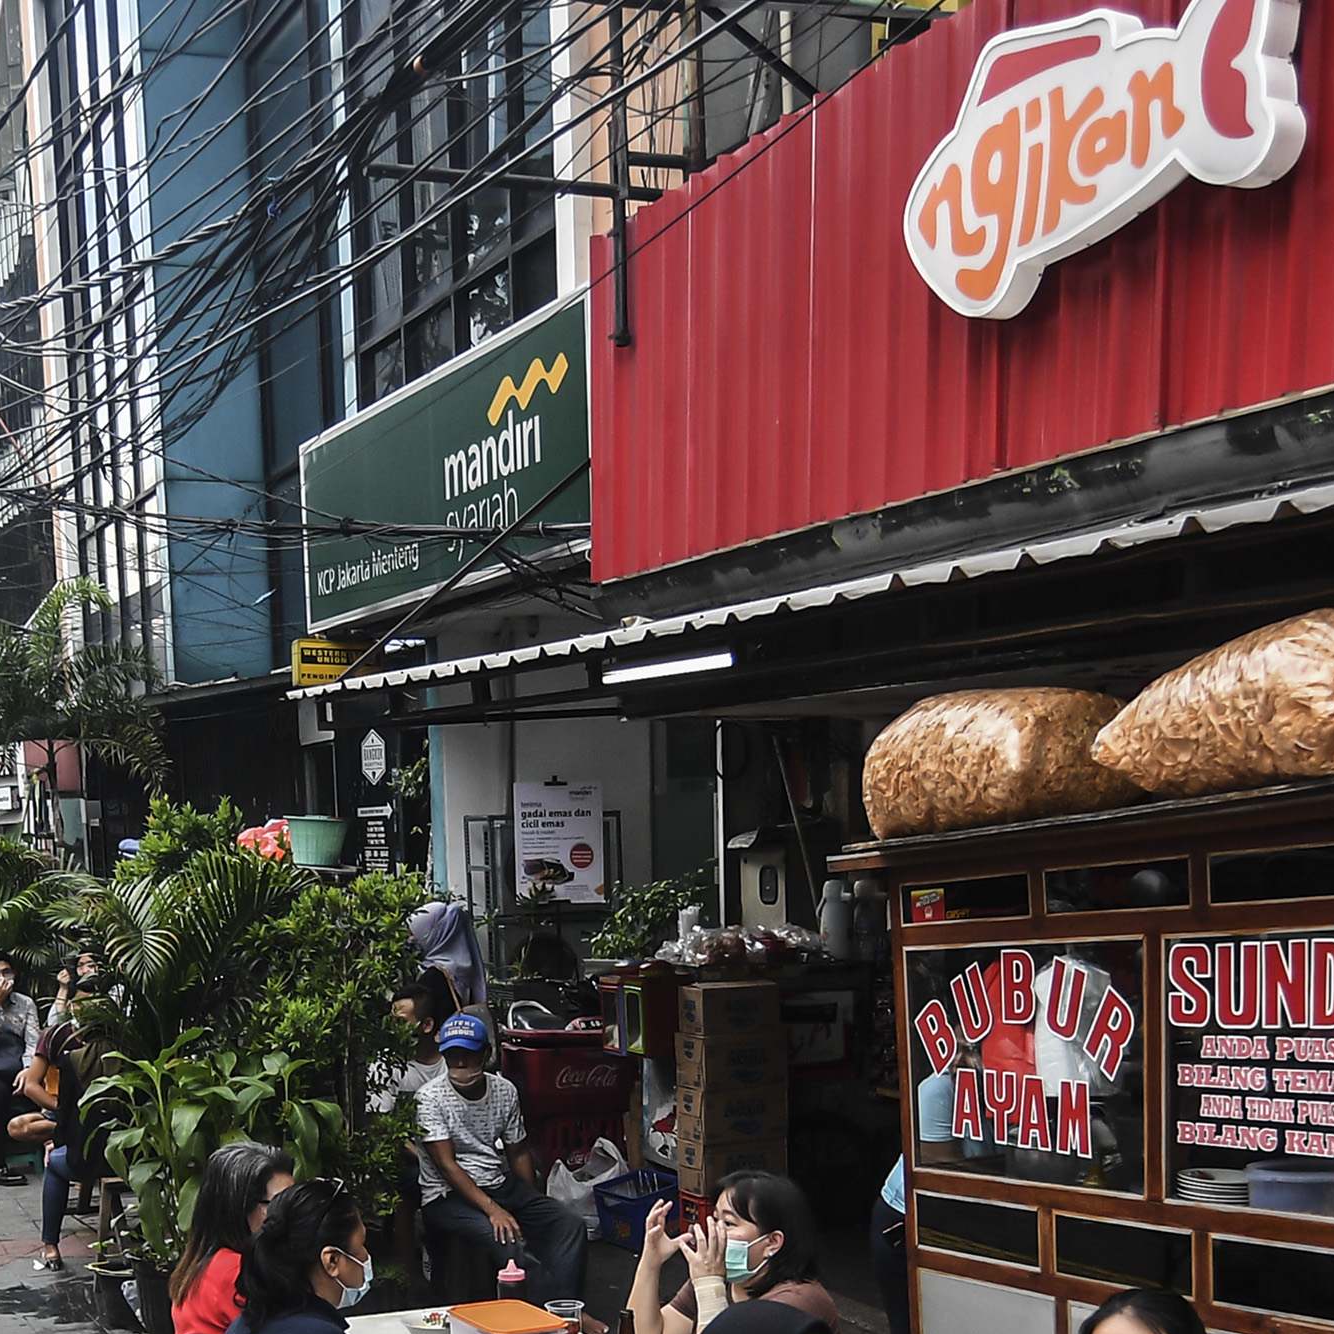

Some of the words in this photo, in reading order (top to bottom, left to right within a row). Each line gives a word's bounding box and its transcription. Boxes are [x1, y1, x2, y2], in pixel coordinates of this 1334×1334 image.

[918, 62, 1195, 301] ngikan
[444, 410, 541, 500] mandiri
[317, 569, 336, 597] KCP
[337, 558, 370, 589] Jakarta
[371, 542, 419, 580] Menteng
[302, 649, 348, 658] WESTERN
[317, 656, 347, 664] UNION
[521, 809, 546, 820] gadai
[548, 810, 573, 818] emas
[574, 808, 592, 817] dan
[521, 820, 539, 829] cicil
[541, 820, 565, 828] emas
[914, 949, 1135, 1082] BUBUR
[1200, 1034, 1270, 1060] ANDA
[1177, 1063, 1267, 1091] BILANG
[952, 1068, 1092, 1159] AYAM
[1199, 1094, 1242, 1119] ANDA
[1245, 1096, 1295, 1124] TIDAK
[1177, 1121, 1278, 1152] BILANG
